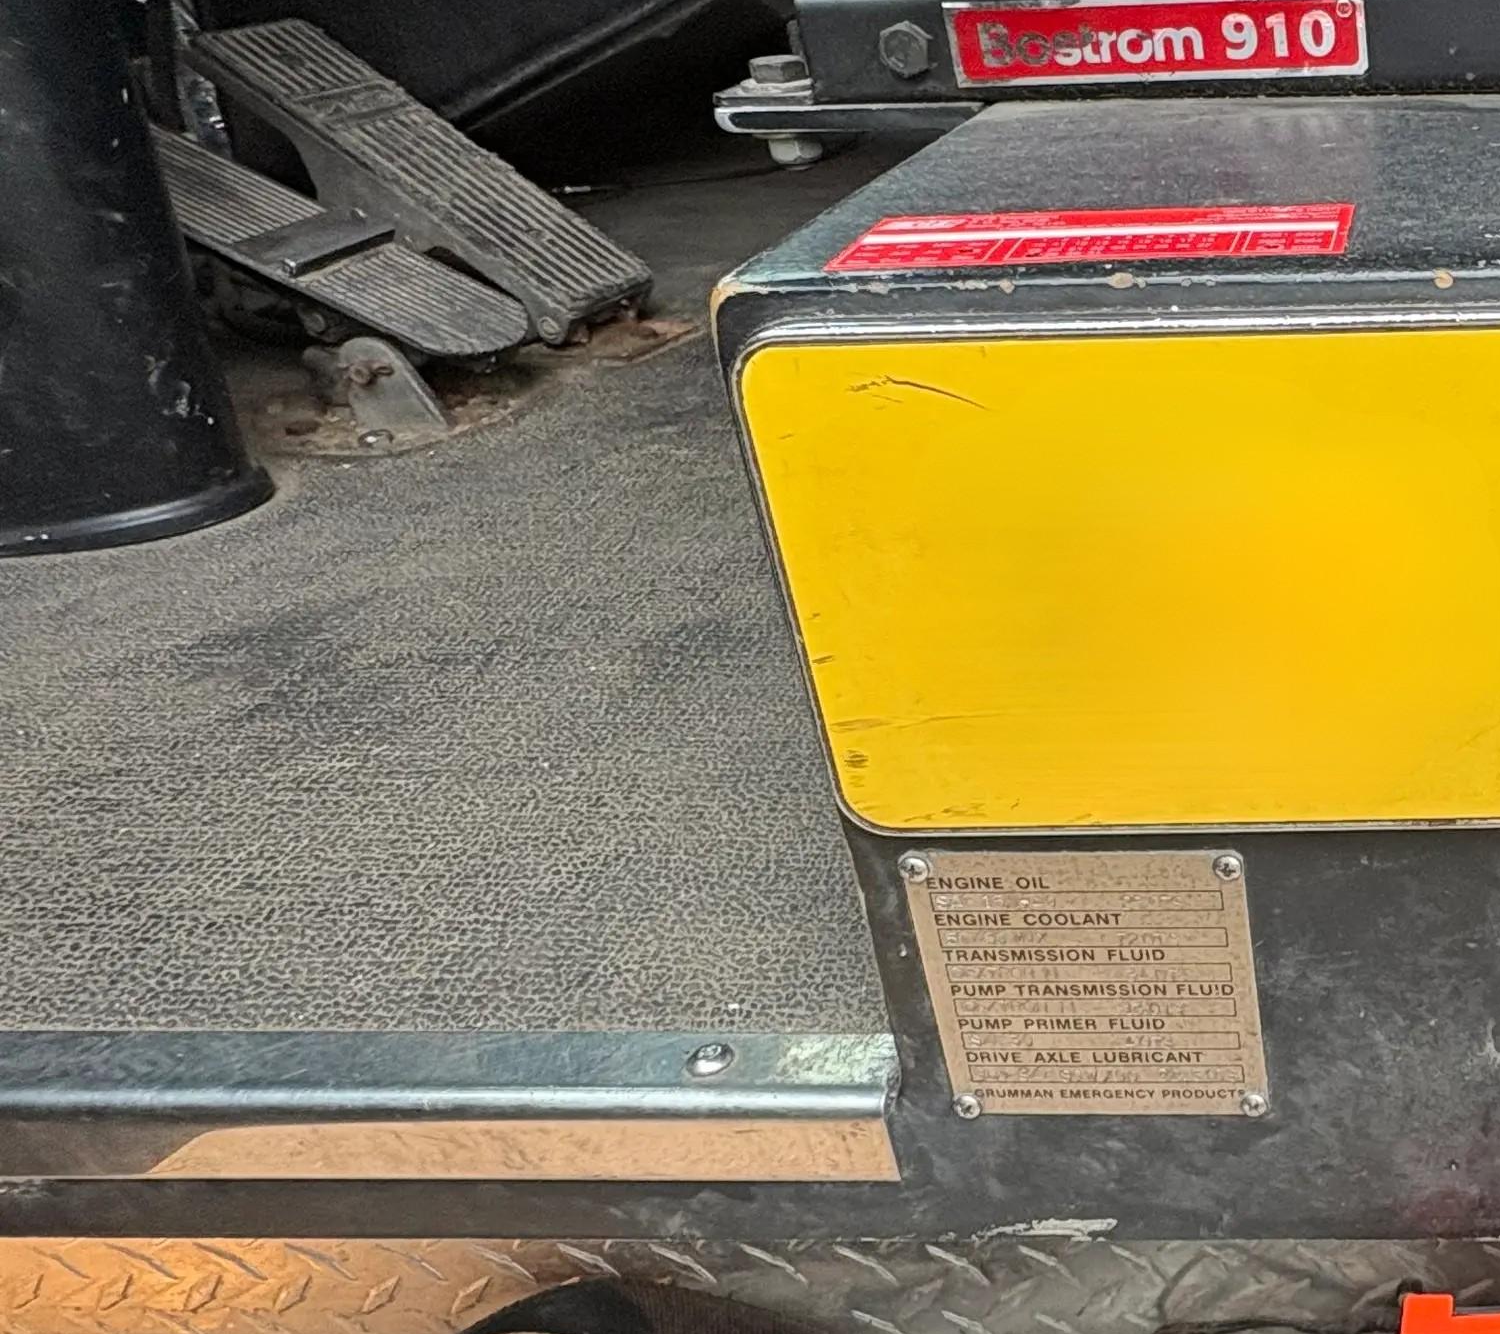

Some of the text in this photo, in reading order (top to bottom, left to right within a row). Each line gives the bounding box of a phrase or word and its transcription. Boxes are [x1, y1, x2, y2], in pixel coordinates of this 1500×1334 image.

[976, 9, 1337, 68] Bostrom 910
[927, 877, 1050, 890] ENGINE OIL
[934, 913, 1121, 926] ENGINE COOLANT
[941, 949, 1165, 962] TRANSMISSION FLUID
[951, 984, 1234, 996] PUMP TRANSMISSION FLUID
[958, 1019, 1165, 1030] PUMP PRIMER FLUID
[965, 1051, 1203, 1063] DRIVE AXLE LUBRICANT
[974, 1089, 1053, 1099] GRUMMAN
[1060, 1089, 1155, 1099] EMERGENCY
